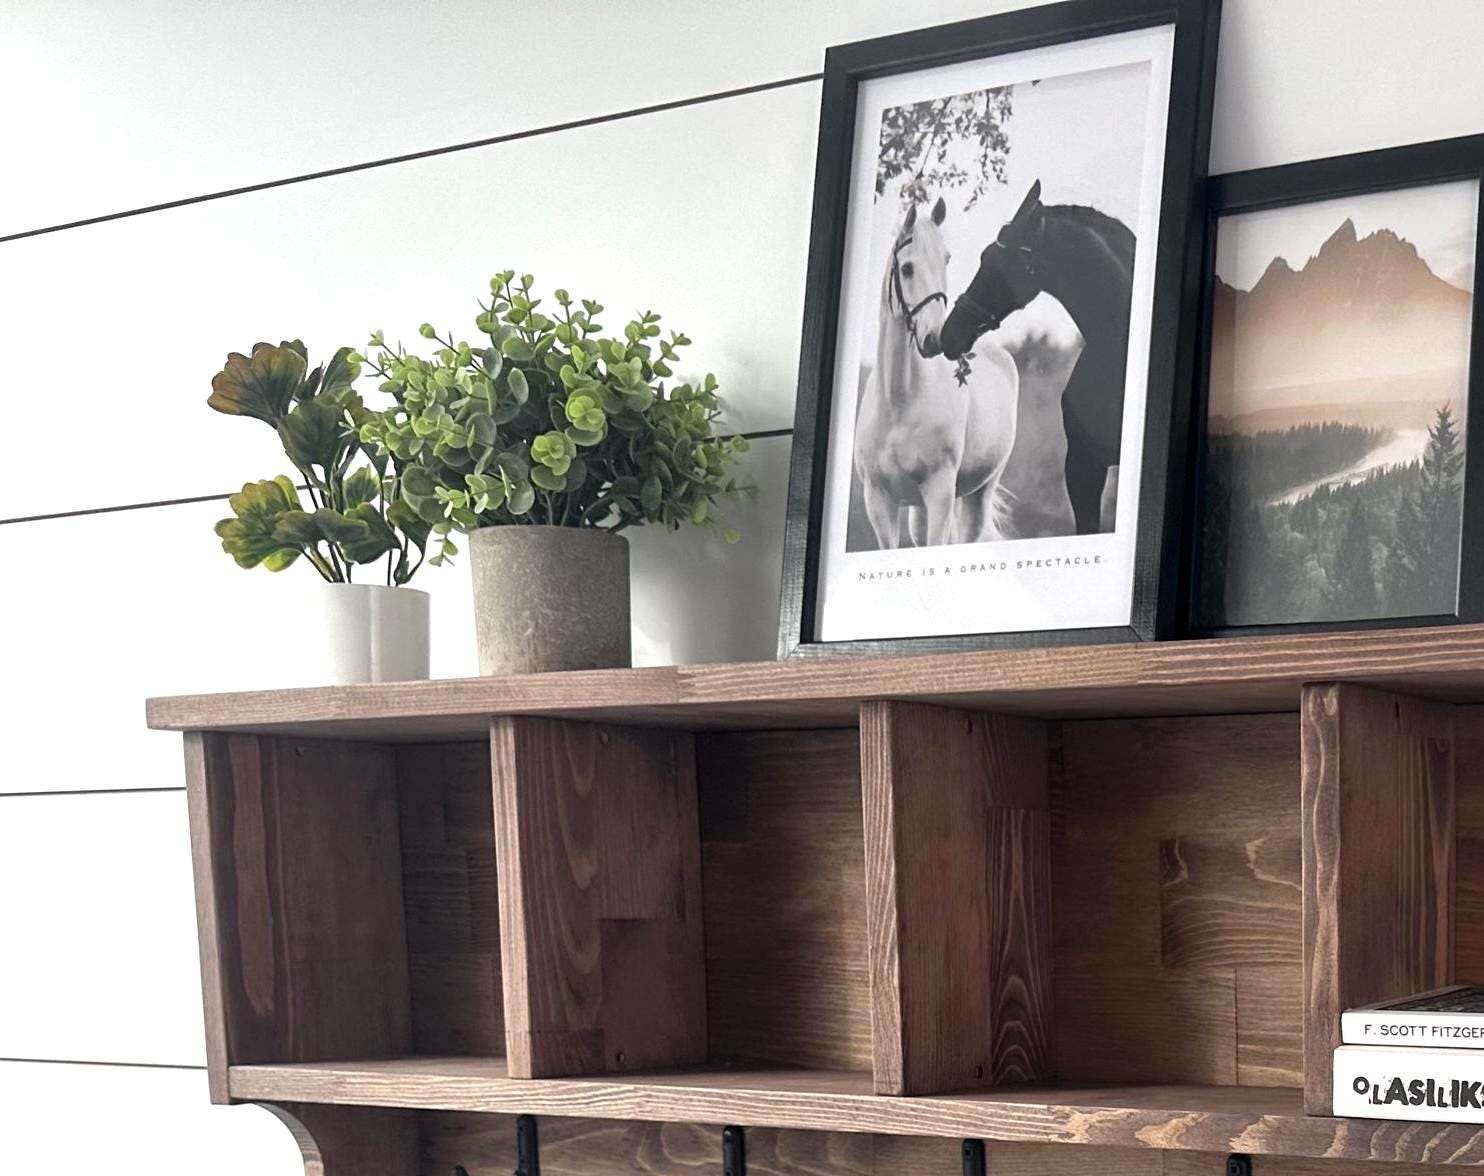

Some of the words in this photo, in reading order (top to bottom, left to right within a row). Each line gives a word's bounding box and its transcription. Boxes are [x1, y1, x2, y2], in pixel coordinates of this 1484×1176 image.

[859, 570, 913, 582] NATURE
[922, 568, 935, 577] IS
[944, 566, 951, 575] A
[960, 562, 1007, 574] GRAND
[1364, 1024, 1377, 1037] F.
[1380, 1024, 1428, 1038] SCOTT
